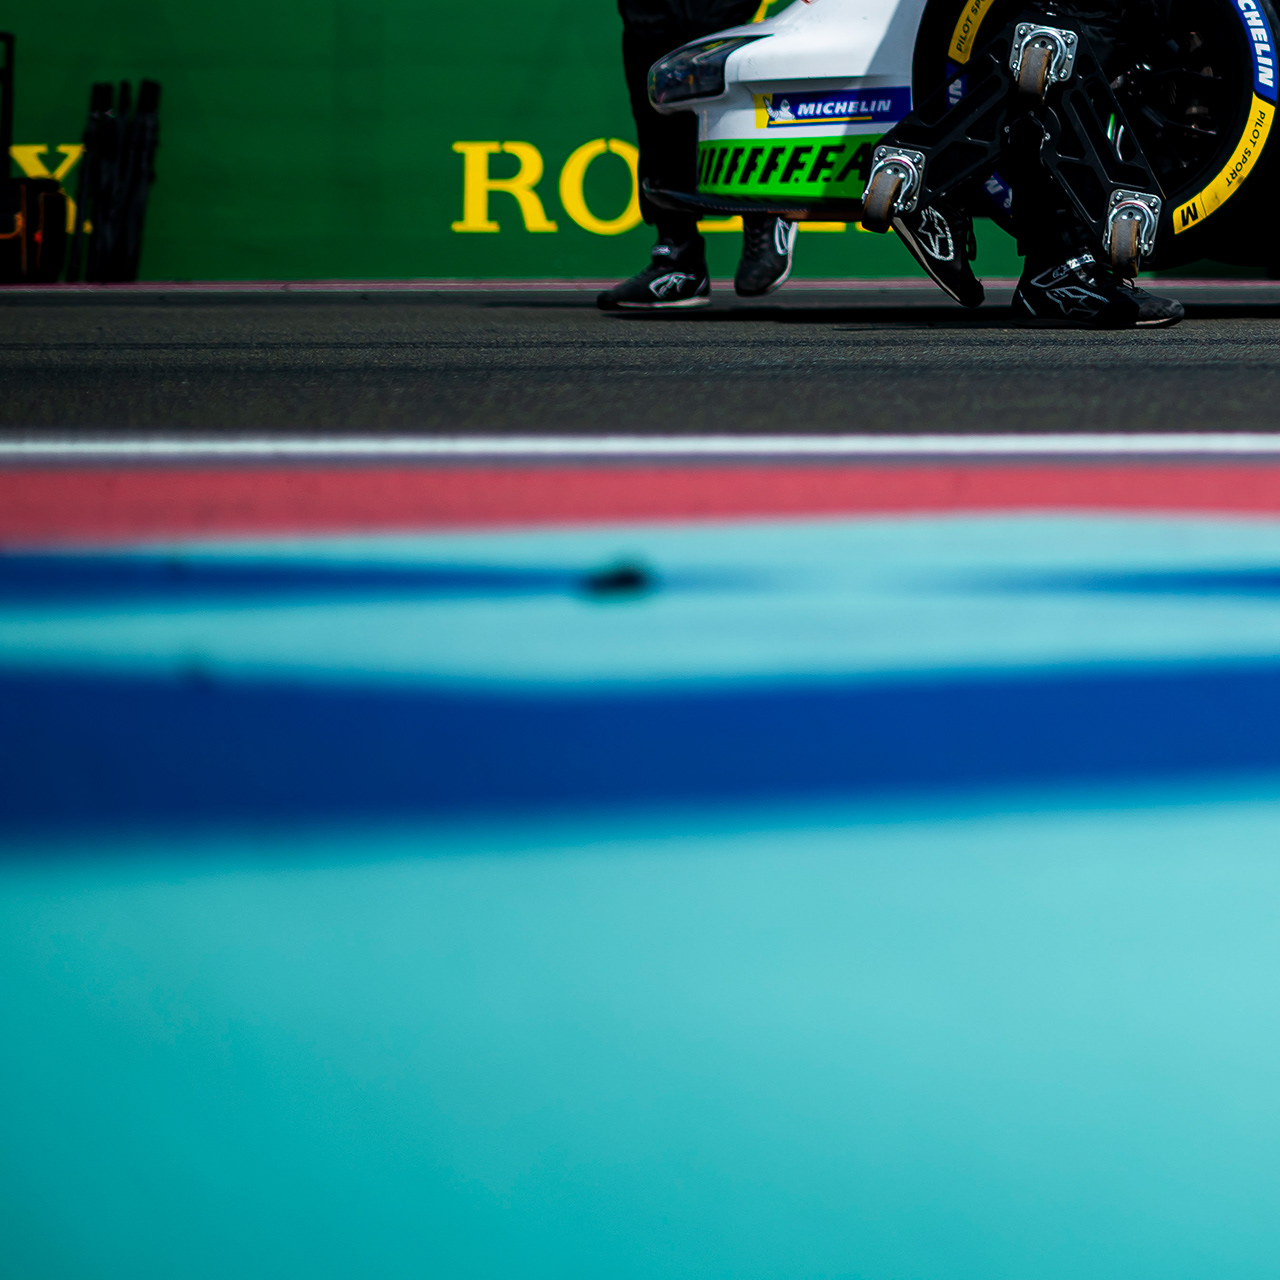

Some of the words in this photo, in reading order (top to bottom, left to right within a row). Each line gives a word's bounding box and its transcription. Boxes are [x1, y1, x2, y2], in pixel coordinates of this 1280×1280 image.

[956, 17, 973, 53] PILOT
[798, 97, 892, 118] MICHELIN
[1246, 110, 1268, 149] PILOT
[1225, 148, 1252, 188] SPORT
